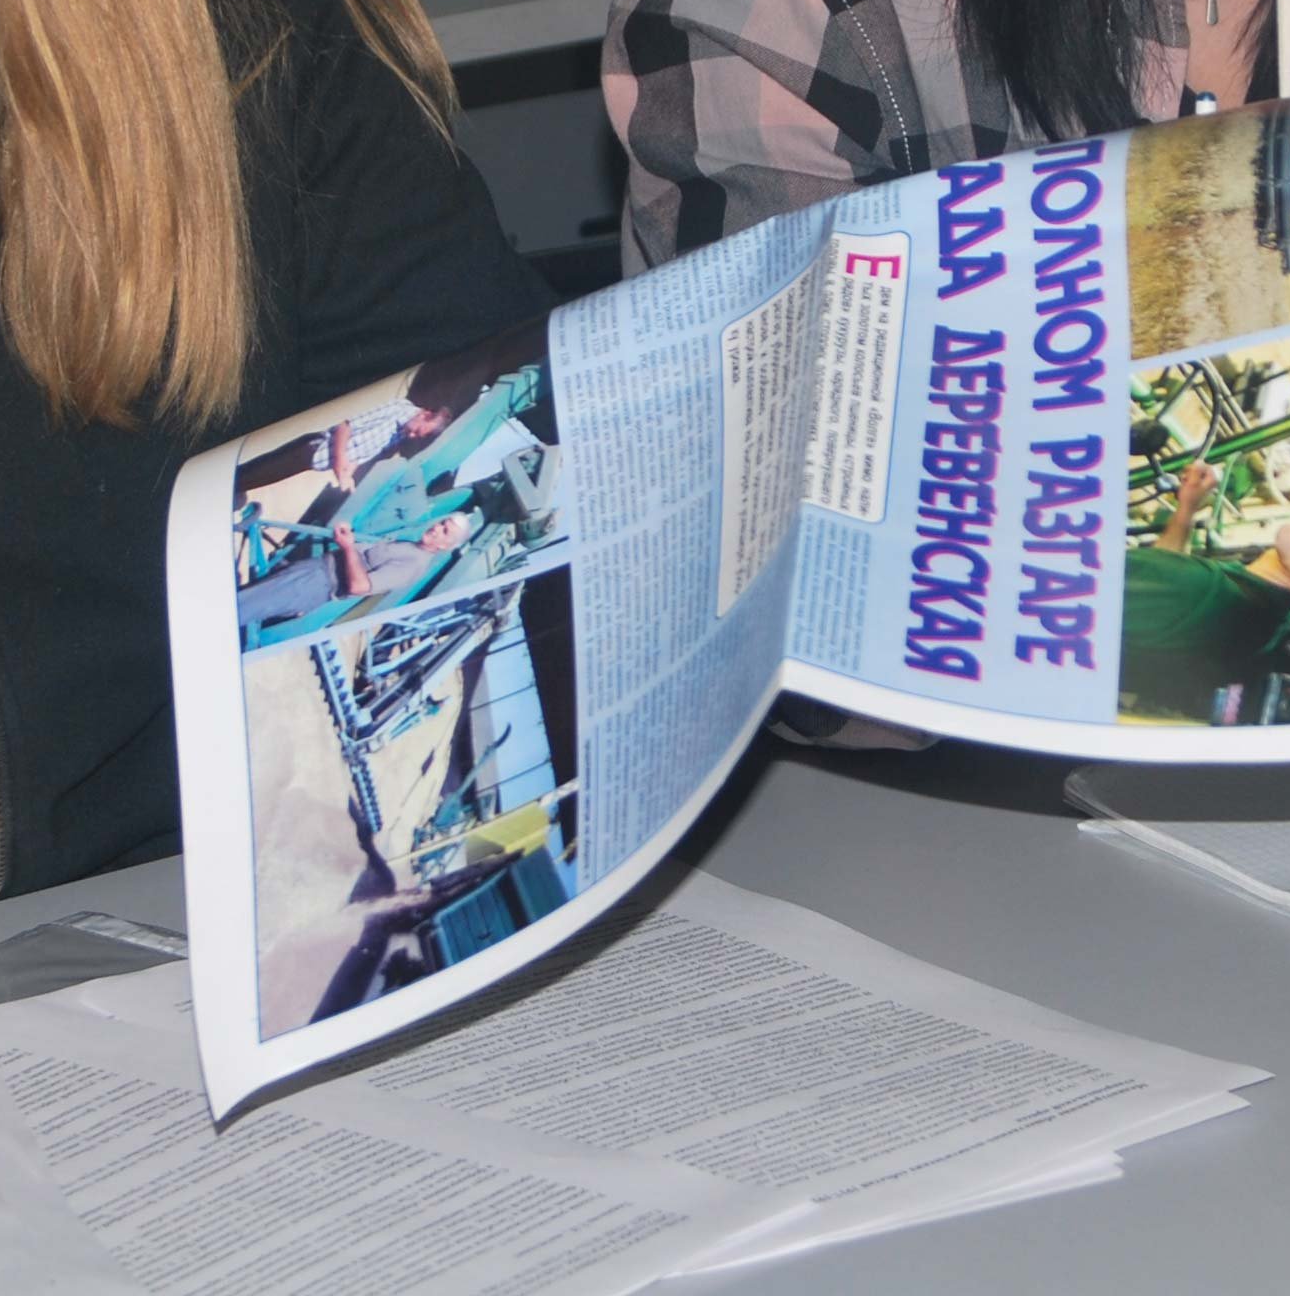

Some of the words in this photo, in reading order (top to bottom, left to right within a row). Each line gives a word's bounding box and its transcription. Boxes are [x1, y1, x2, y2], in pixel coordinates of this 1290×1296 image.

[936, 160, 1007, 301] АДА
[1030, 138, 1110, 412] ПОЛНОМ
[903, 323, 1007, 682] ДЕРЕВЕНСКАЯ
[1014, 433, 1105, 671] РАЗГАРЕ
